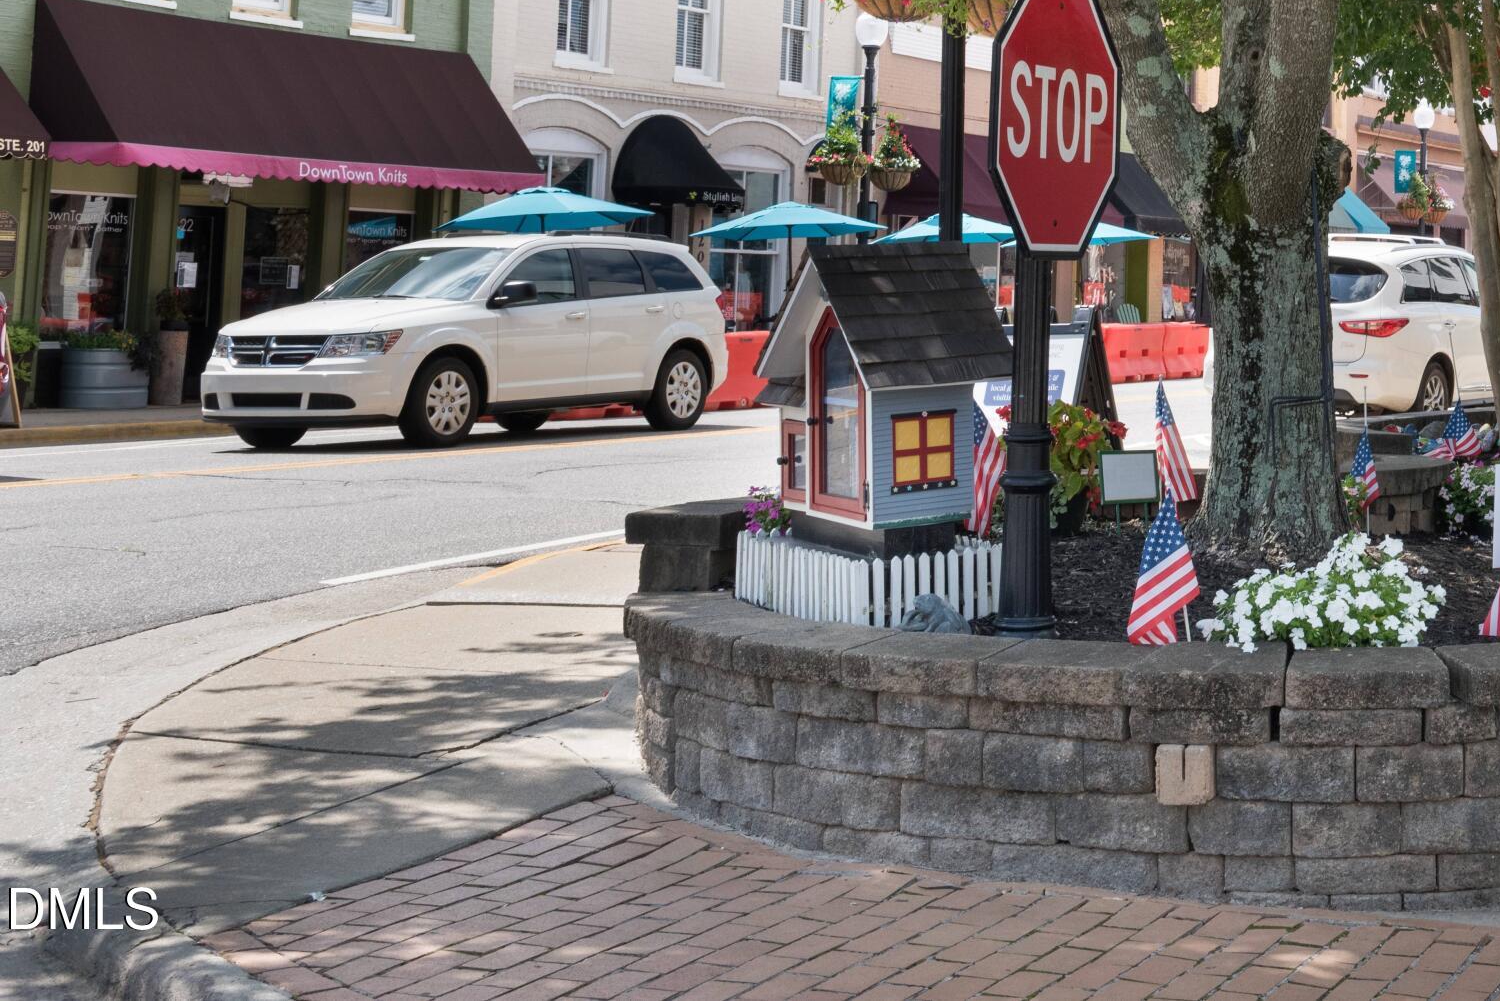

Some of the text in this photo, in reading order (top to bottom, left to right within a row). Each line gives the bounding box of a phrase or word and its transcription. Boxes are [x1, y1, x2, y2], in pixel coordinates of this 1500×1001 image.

[1006, 59, 1108, 164] STOP
[26, 140, 45, 153] 201
[299, 161, 408, 184] DownTown Knits
[103, 212, 128, 225] Knits
